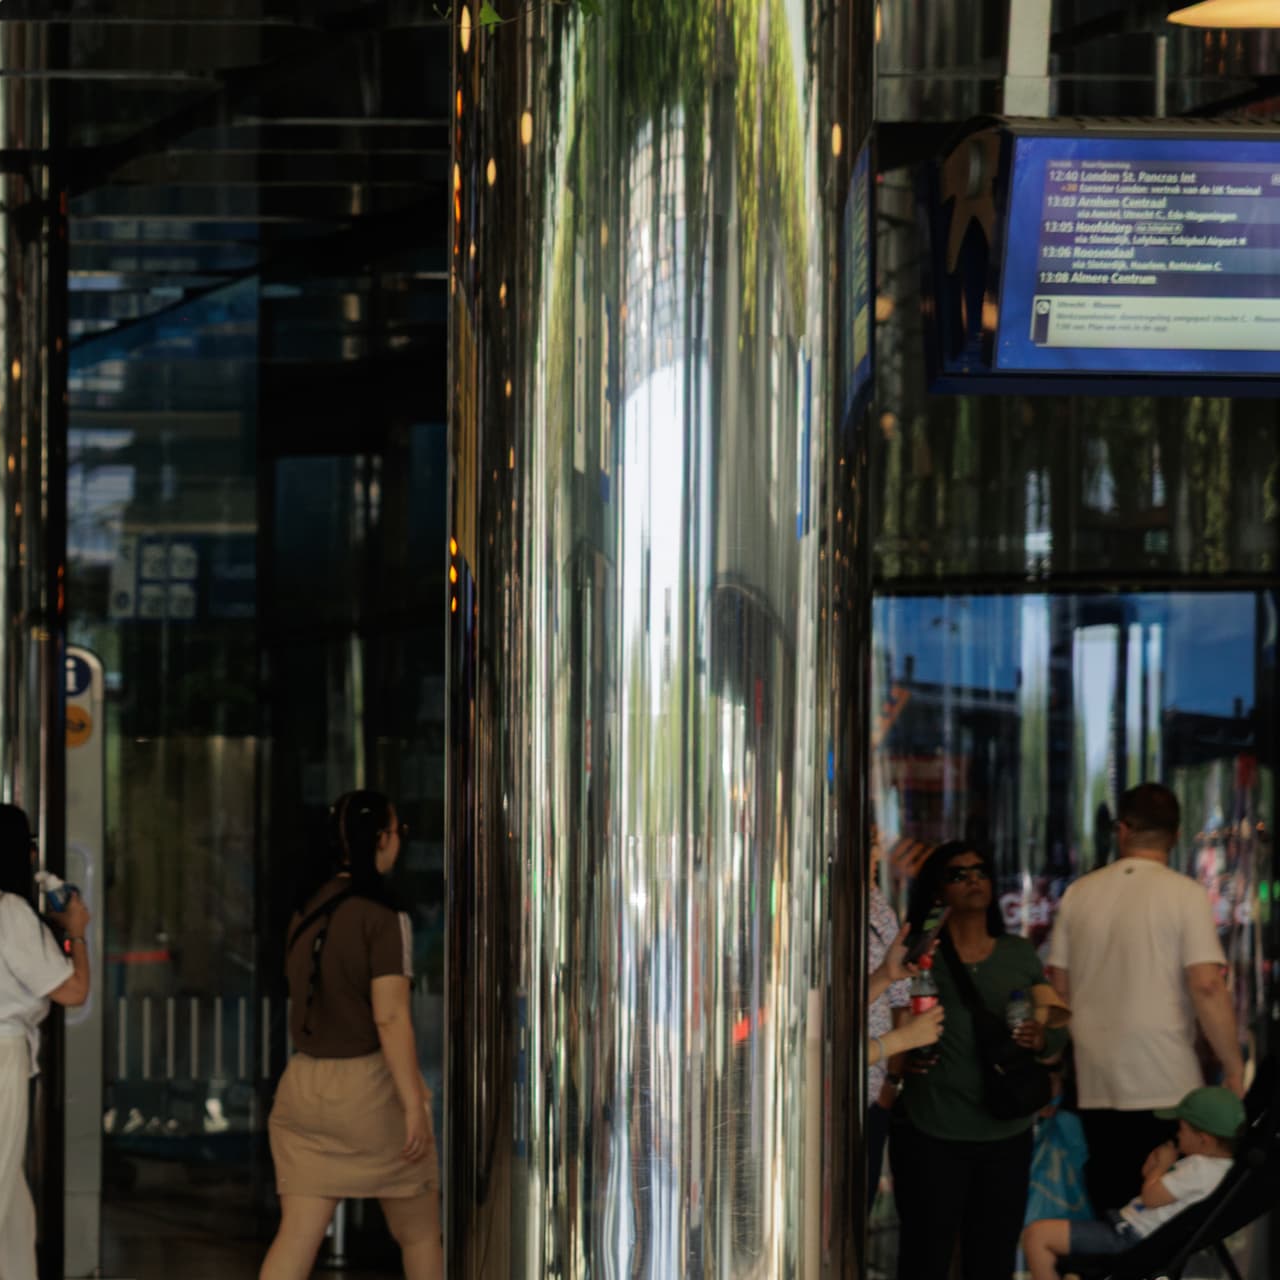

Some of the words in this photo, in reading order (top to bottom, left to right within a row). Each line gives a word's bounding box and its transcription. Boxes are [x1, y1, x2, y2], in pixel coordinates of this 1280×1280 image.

[1080, 170, 1120, 182] London
[1138, 171, 1178, 183] Pancras
[1180, 171, 1196, 183] Int
[1077, 196, 1120, 208] Arnhem
[1122, 197, 1167, 209] Centraal
[1075, 221, 1133, 234] Hoofddorp
[1073, 247, 1135, 259] Roosendaal
[1071, 272, 1109, 283] Almere
[1111, 272, 1157, 284] Centrum
